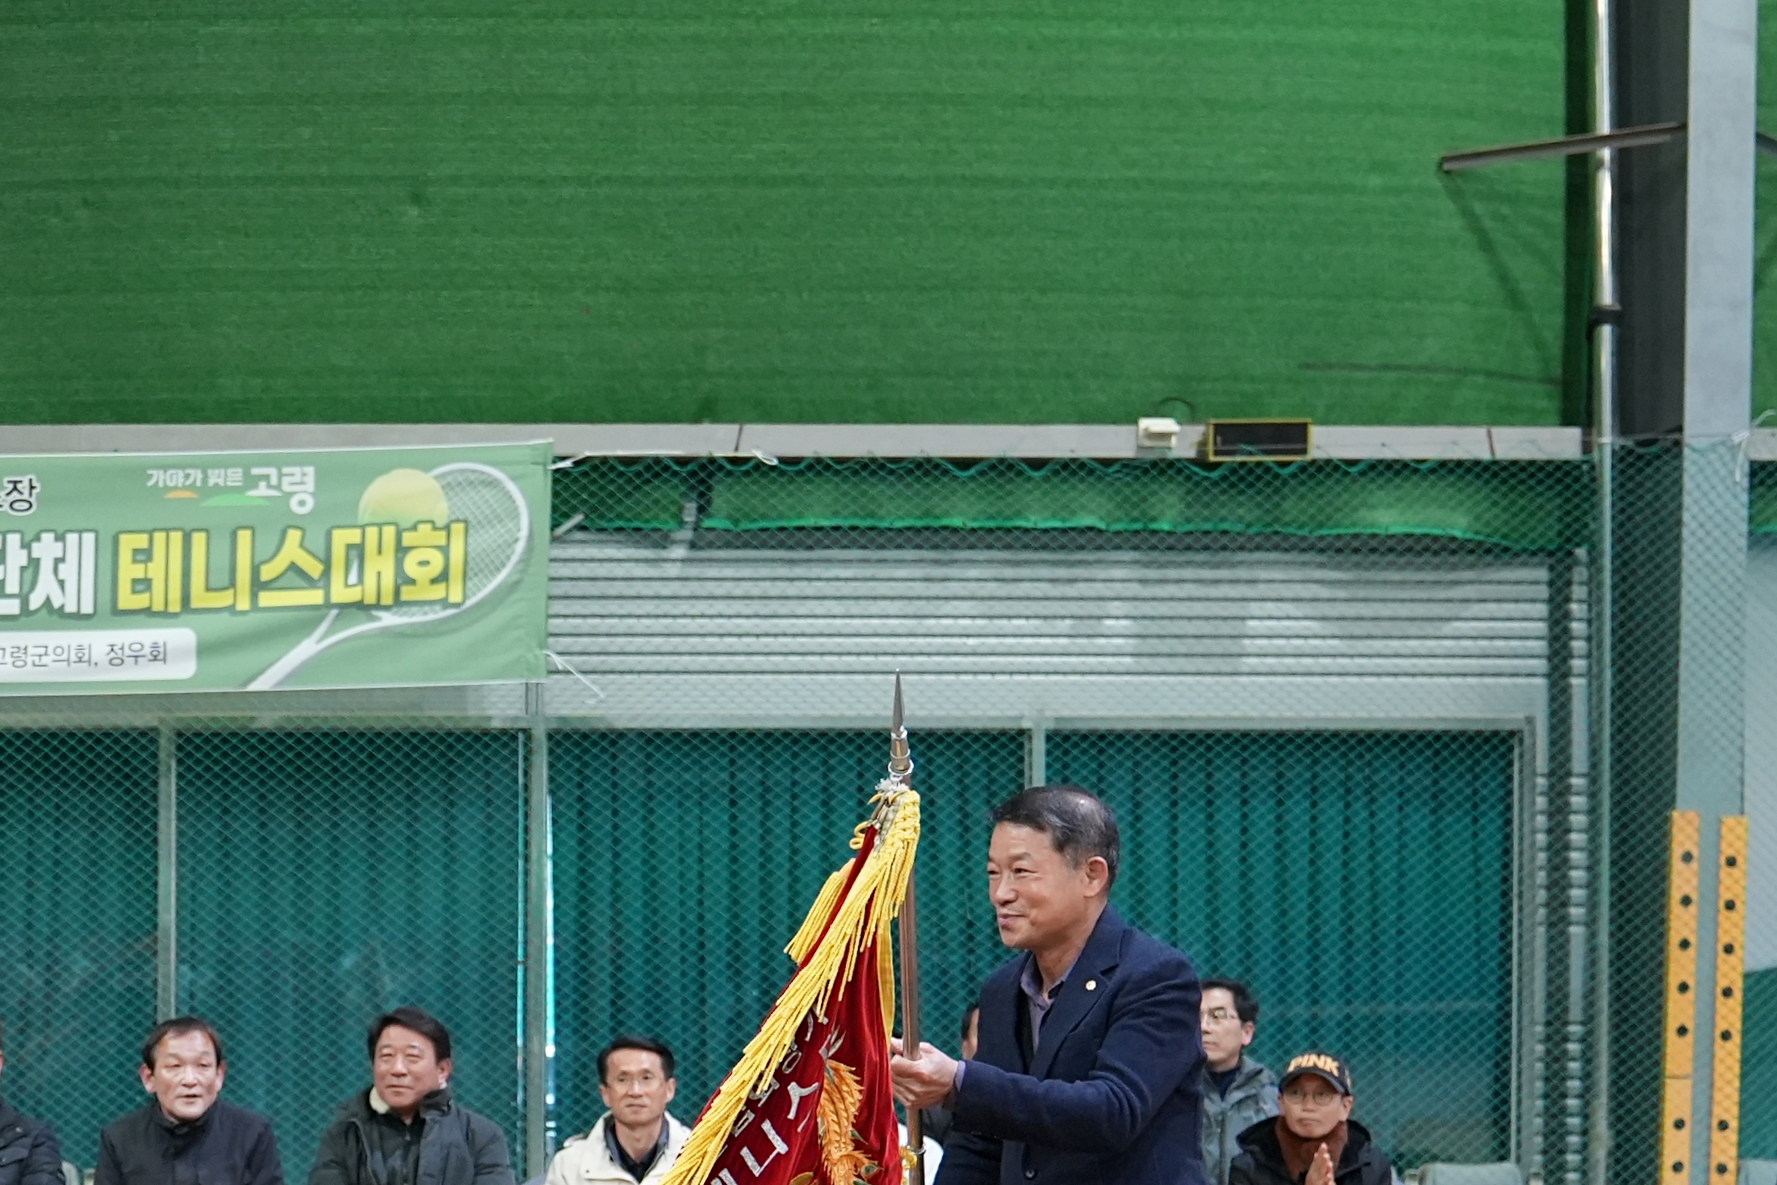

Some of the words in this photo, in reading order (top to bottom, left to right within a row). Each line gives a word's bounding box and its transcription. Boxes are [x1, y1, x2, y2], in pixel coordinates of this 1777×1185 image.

[146, 468, 203, 487] 가야가
[245, 466, 315, 515] 고령
[117, 519, 467, 613] 테니스대회
[105, 640, 168, 666] 정우회
[1287, 1053, 1340, 1078] PINK
